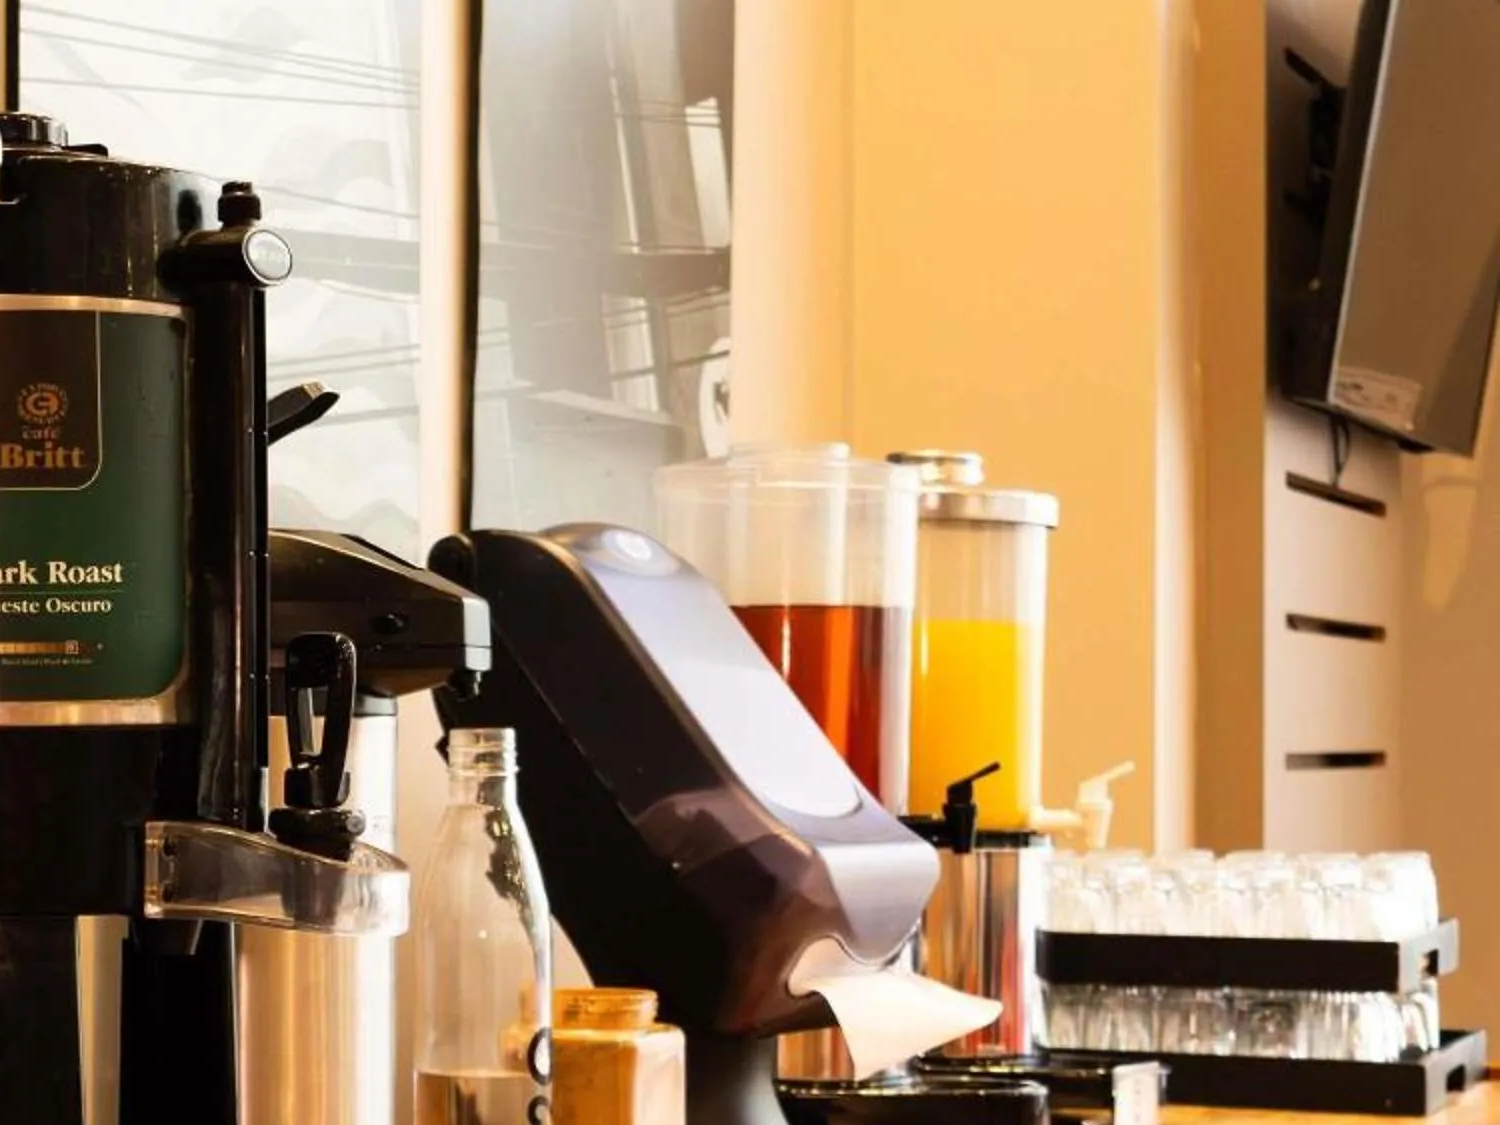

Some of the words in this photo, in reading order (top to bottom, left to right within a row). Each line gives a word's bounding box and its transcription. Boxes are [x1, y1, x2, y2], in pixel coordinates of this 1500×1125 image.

[0, 441, 85, 469] Britt
[47, 561, 123, 583] Roast
[46, 598, 112, 613] Oscuro
